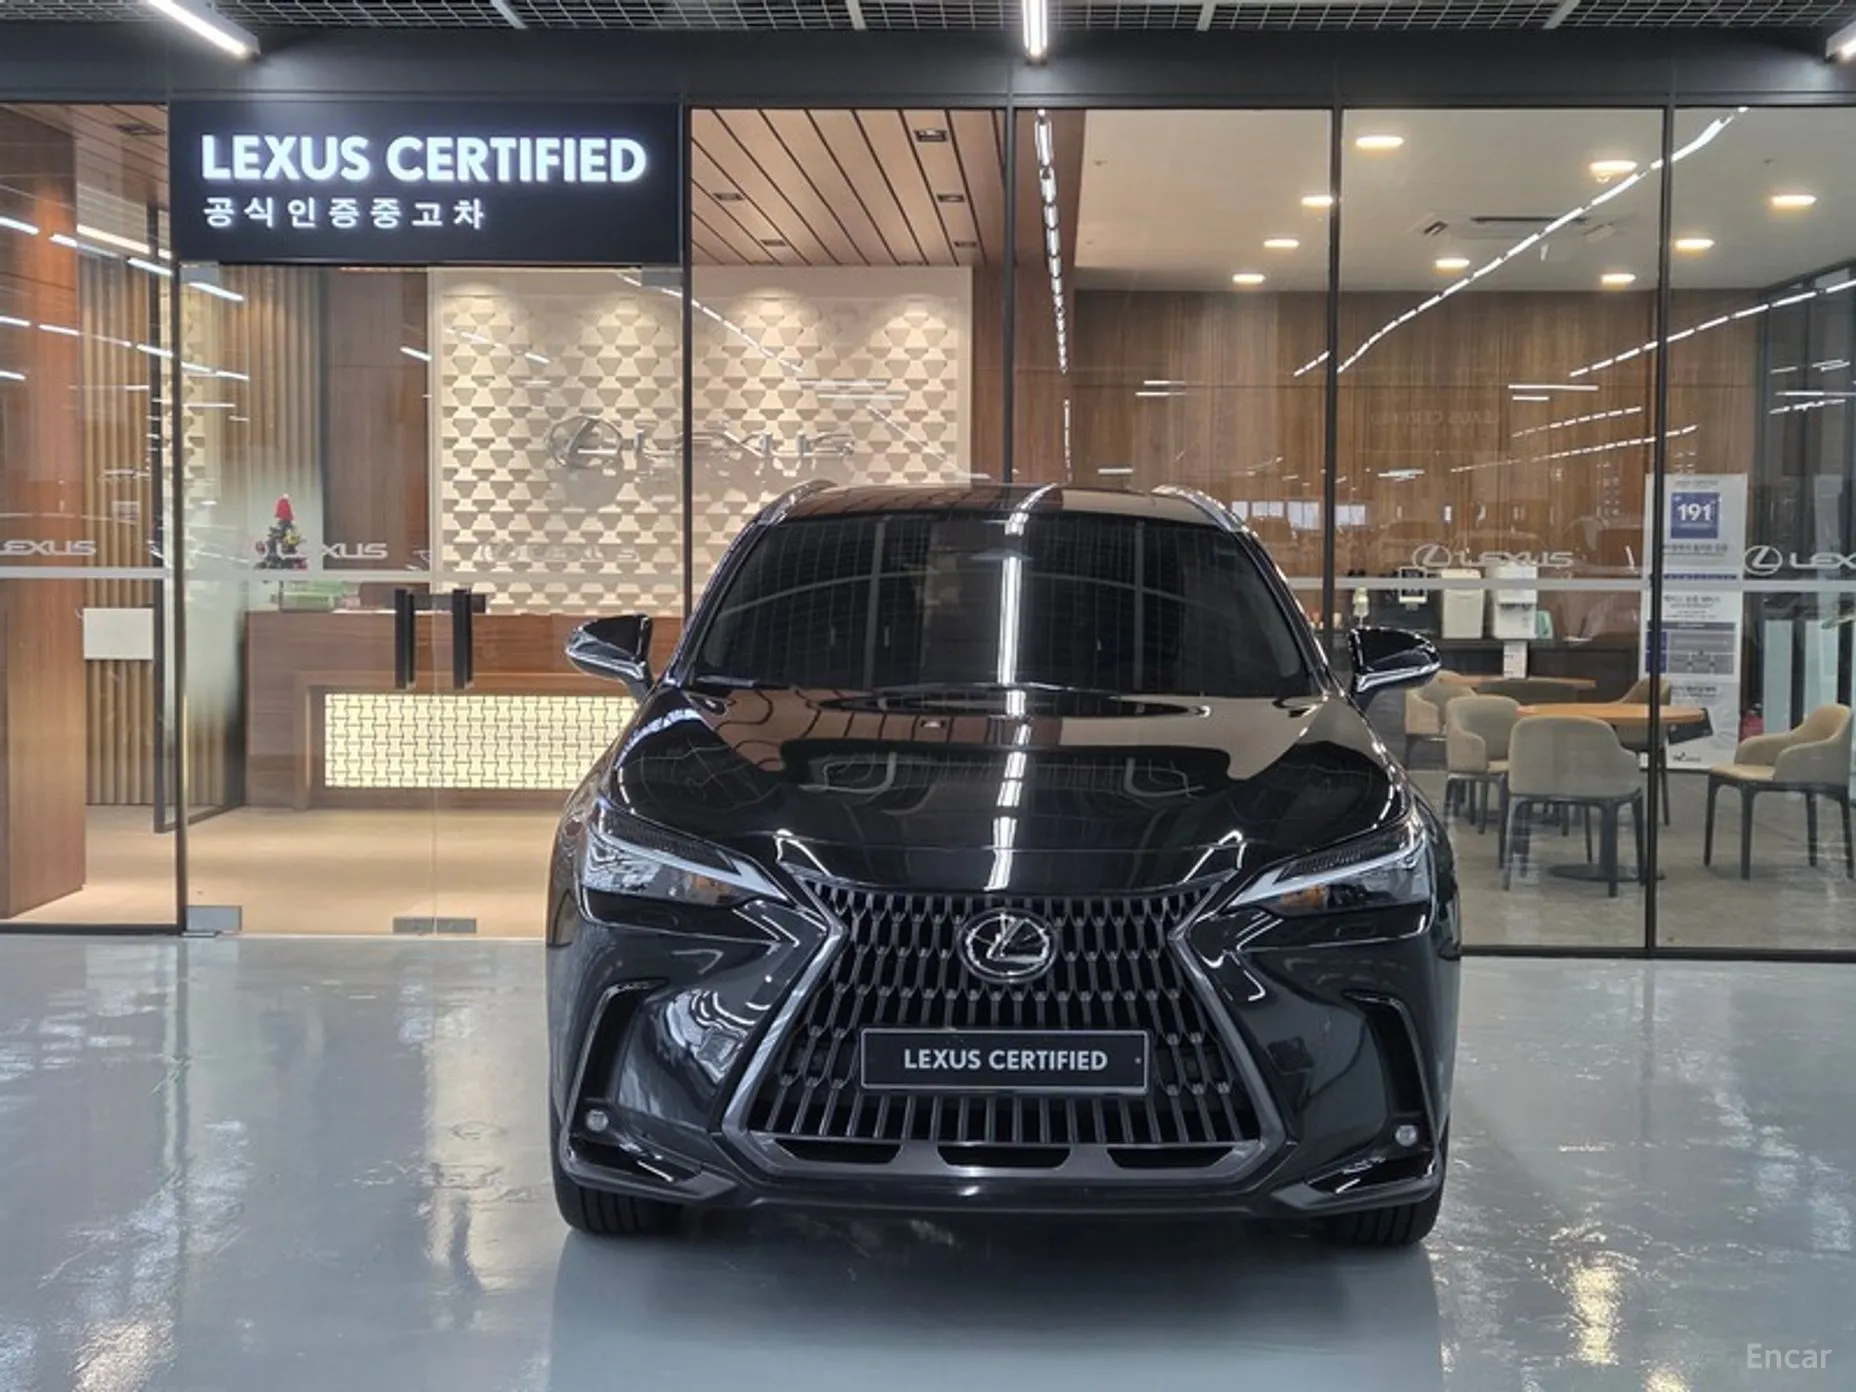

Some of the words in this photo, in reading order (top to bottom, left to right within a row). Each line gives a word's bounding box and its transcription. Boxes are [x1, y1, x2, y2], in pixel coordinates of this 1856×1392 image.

[201, 134, 371, 182] LEXUS
[385, 135, 648, 184] CERTIFIED
[1677, 502, 1713, 521] 191
[1458, 551, 1575, 568] LEXUS
[903, 1048, 982, 1069] LEXUS
[987, 1049, 1108, 1071] CERTIFIED
